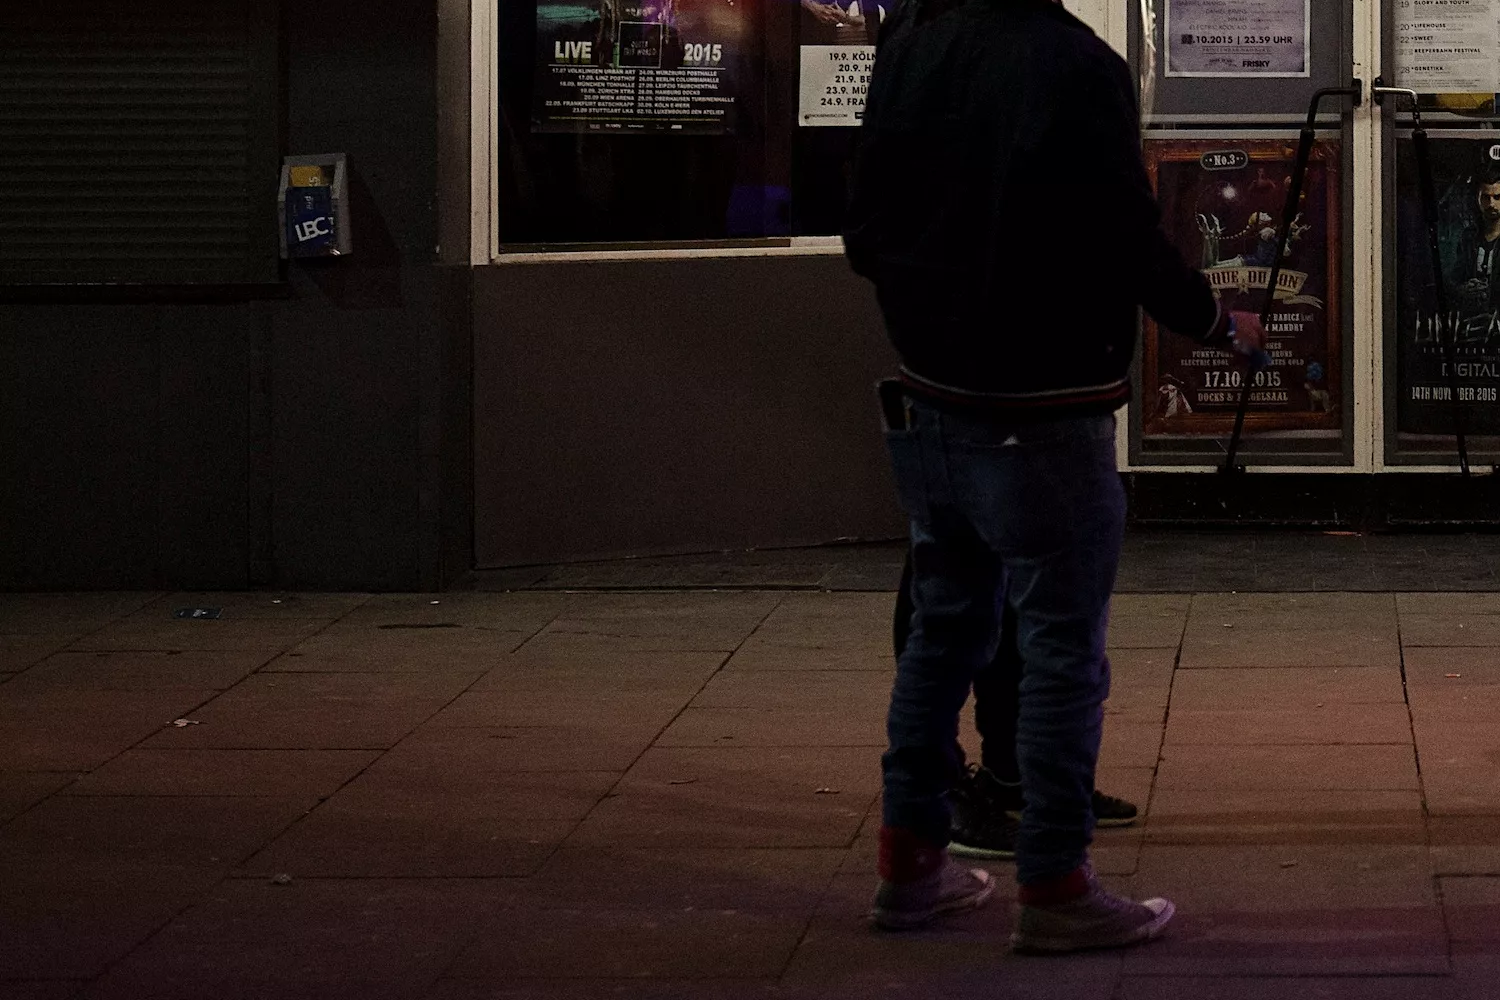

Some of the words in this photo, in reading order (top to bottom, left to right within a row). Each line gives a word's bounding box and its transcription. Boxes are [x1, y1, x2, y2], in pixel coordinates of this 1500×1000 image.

[1244, 36, 1271, 44] 23.59
[1273, 36, 1293, 44] UHR
[554, 40, 592, 60] LIVE
[683, 43, 722, 62] 2015
[829, 52, 850, 61] 19.9.
[839, 64, 861, 72] 20.9.
[1242, 60, 1270, 68] FRISKY
[835, 75, 857, 84] 21.9.
[826, 86, 849, 95] 23.9.
[820, 97, 844, 106] 24.9.
[1213, 154, 1236, 167] No.3
[1204, 371, 1281, 388] 17.10.015
[1197, 392, 1225, 402] DOCKS
[1476, 387, 1497, 401] 2015
